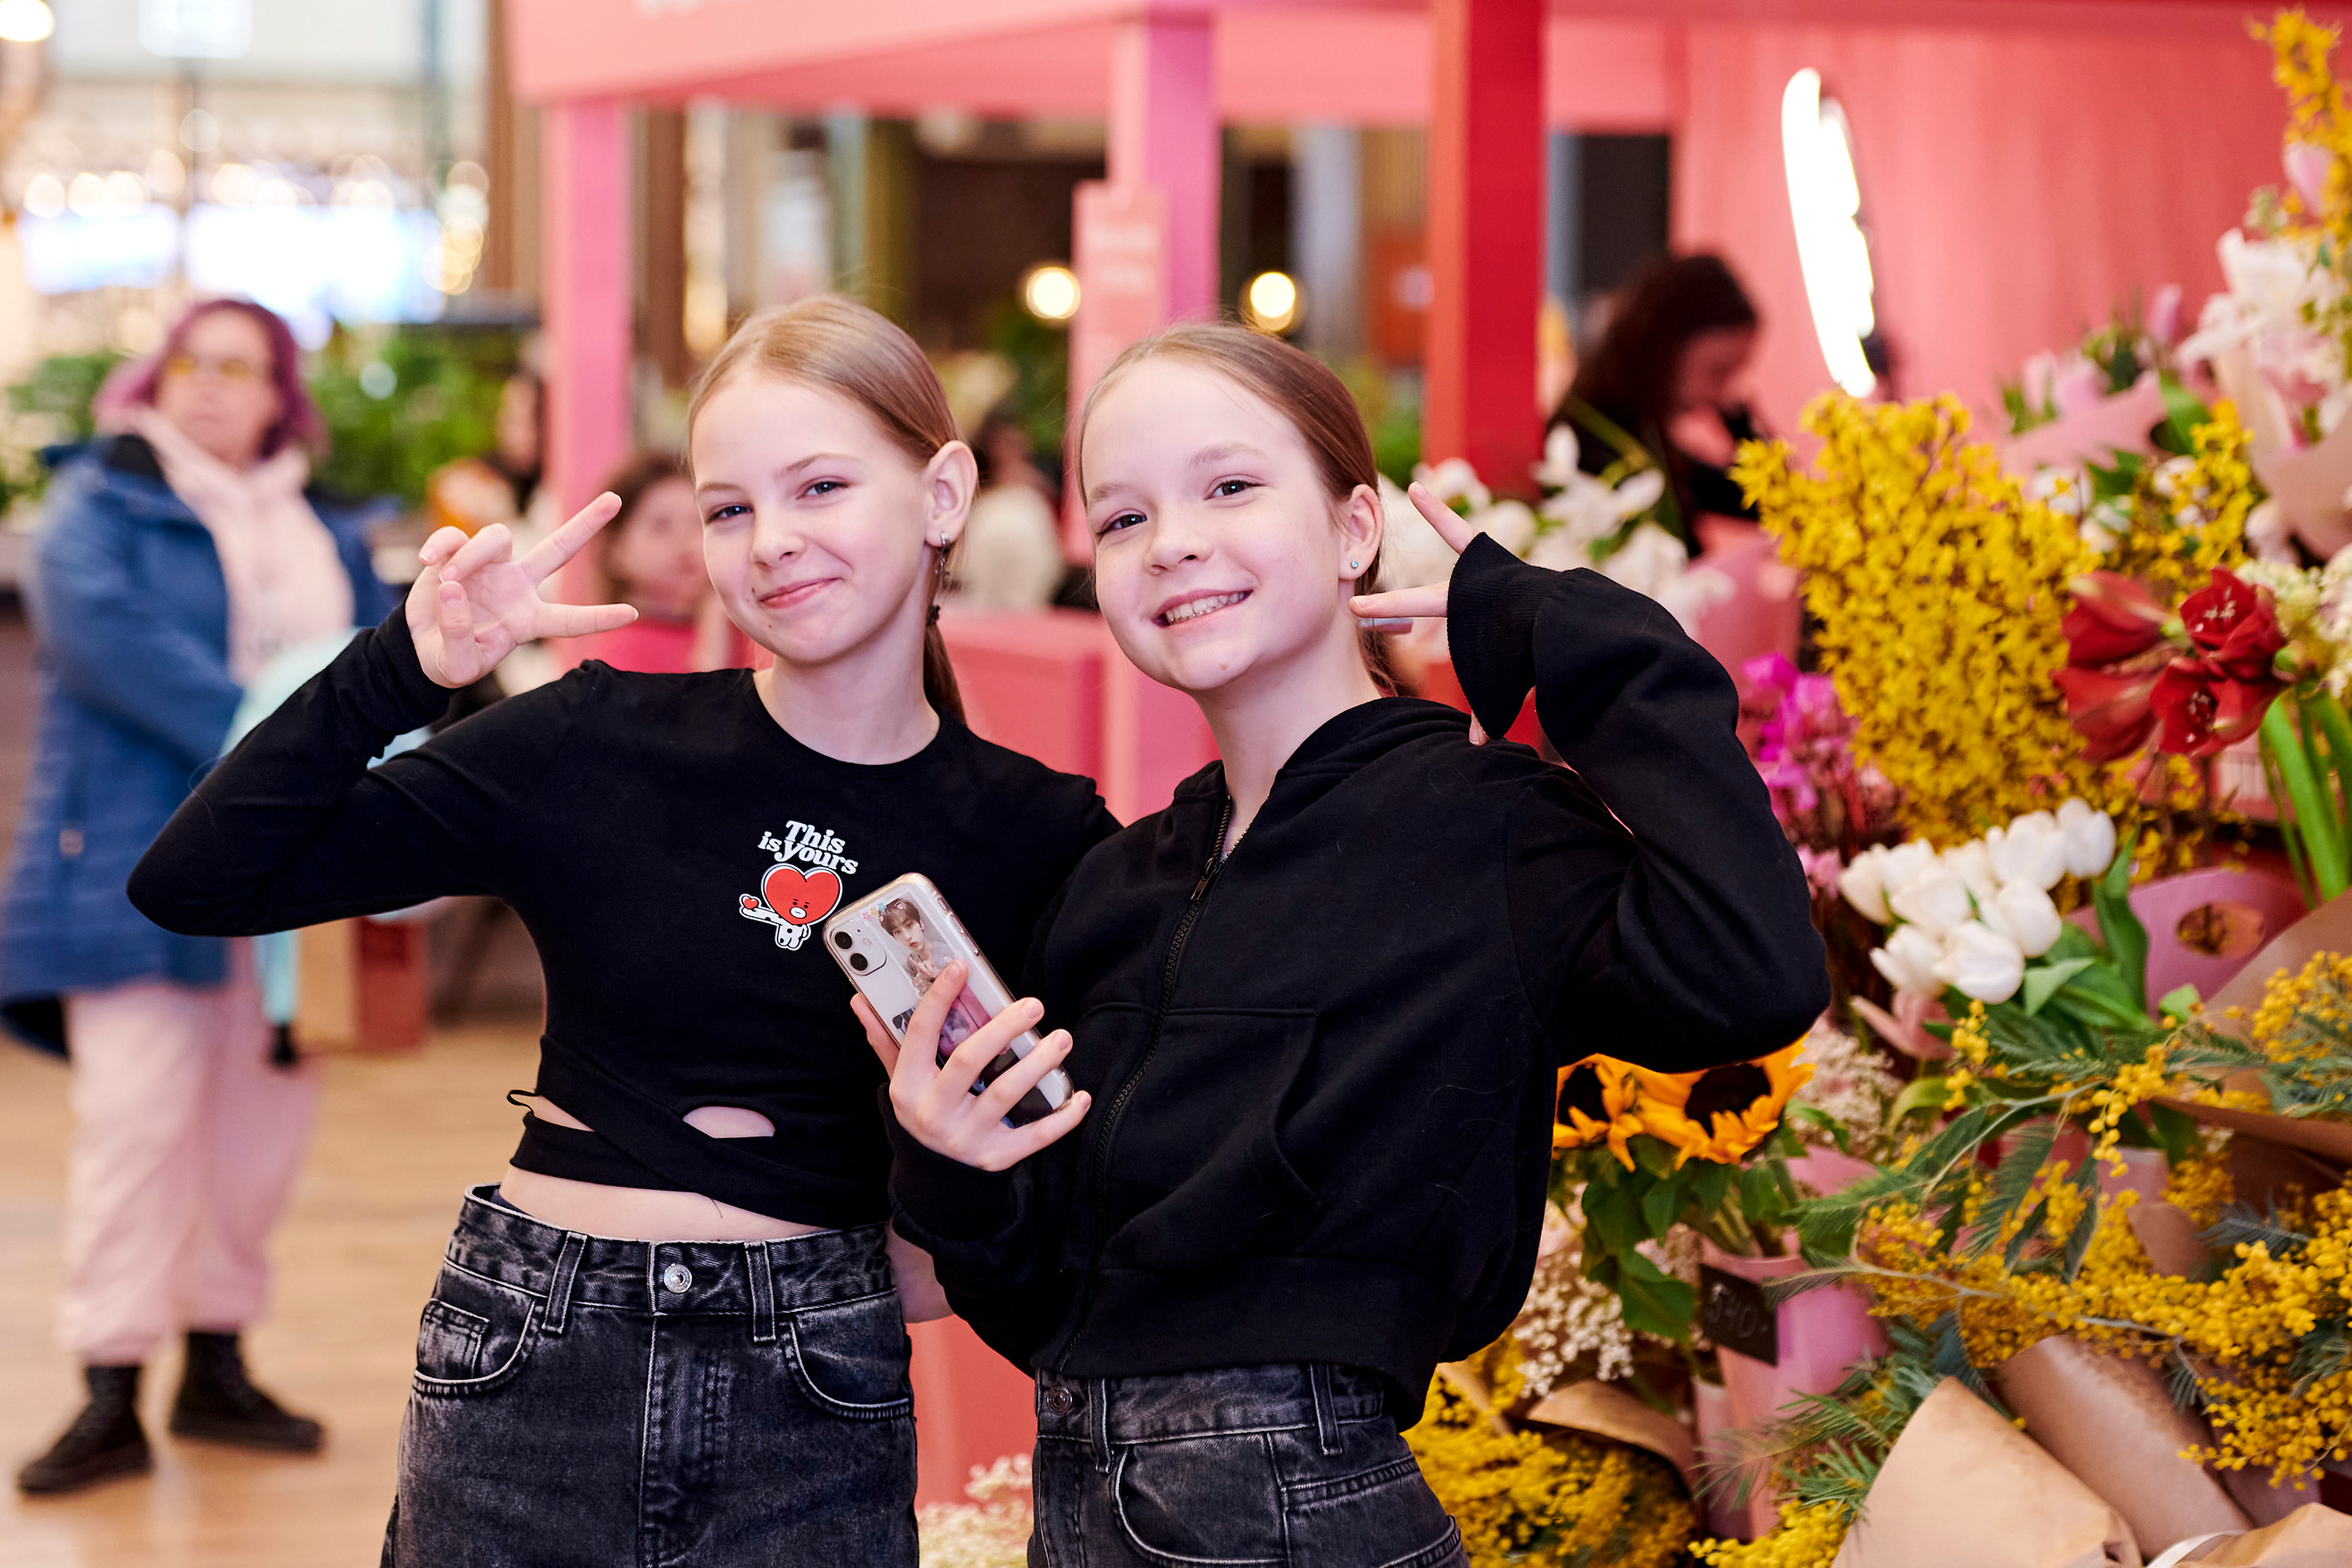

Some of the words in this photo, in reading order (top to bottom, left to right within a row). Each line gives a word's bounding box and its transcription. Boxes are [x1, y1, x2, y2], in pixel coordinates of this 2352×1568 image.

[757, 831, 782, 852] is
[774, 840, 859, 874] yours
[786, 820, 846, 854] This
